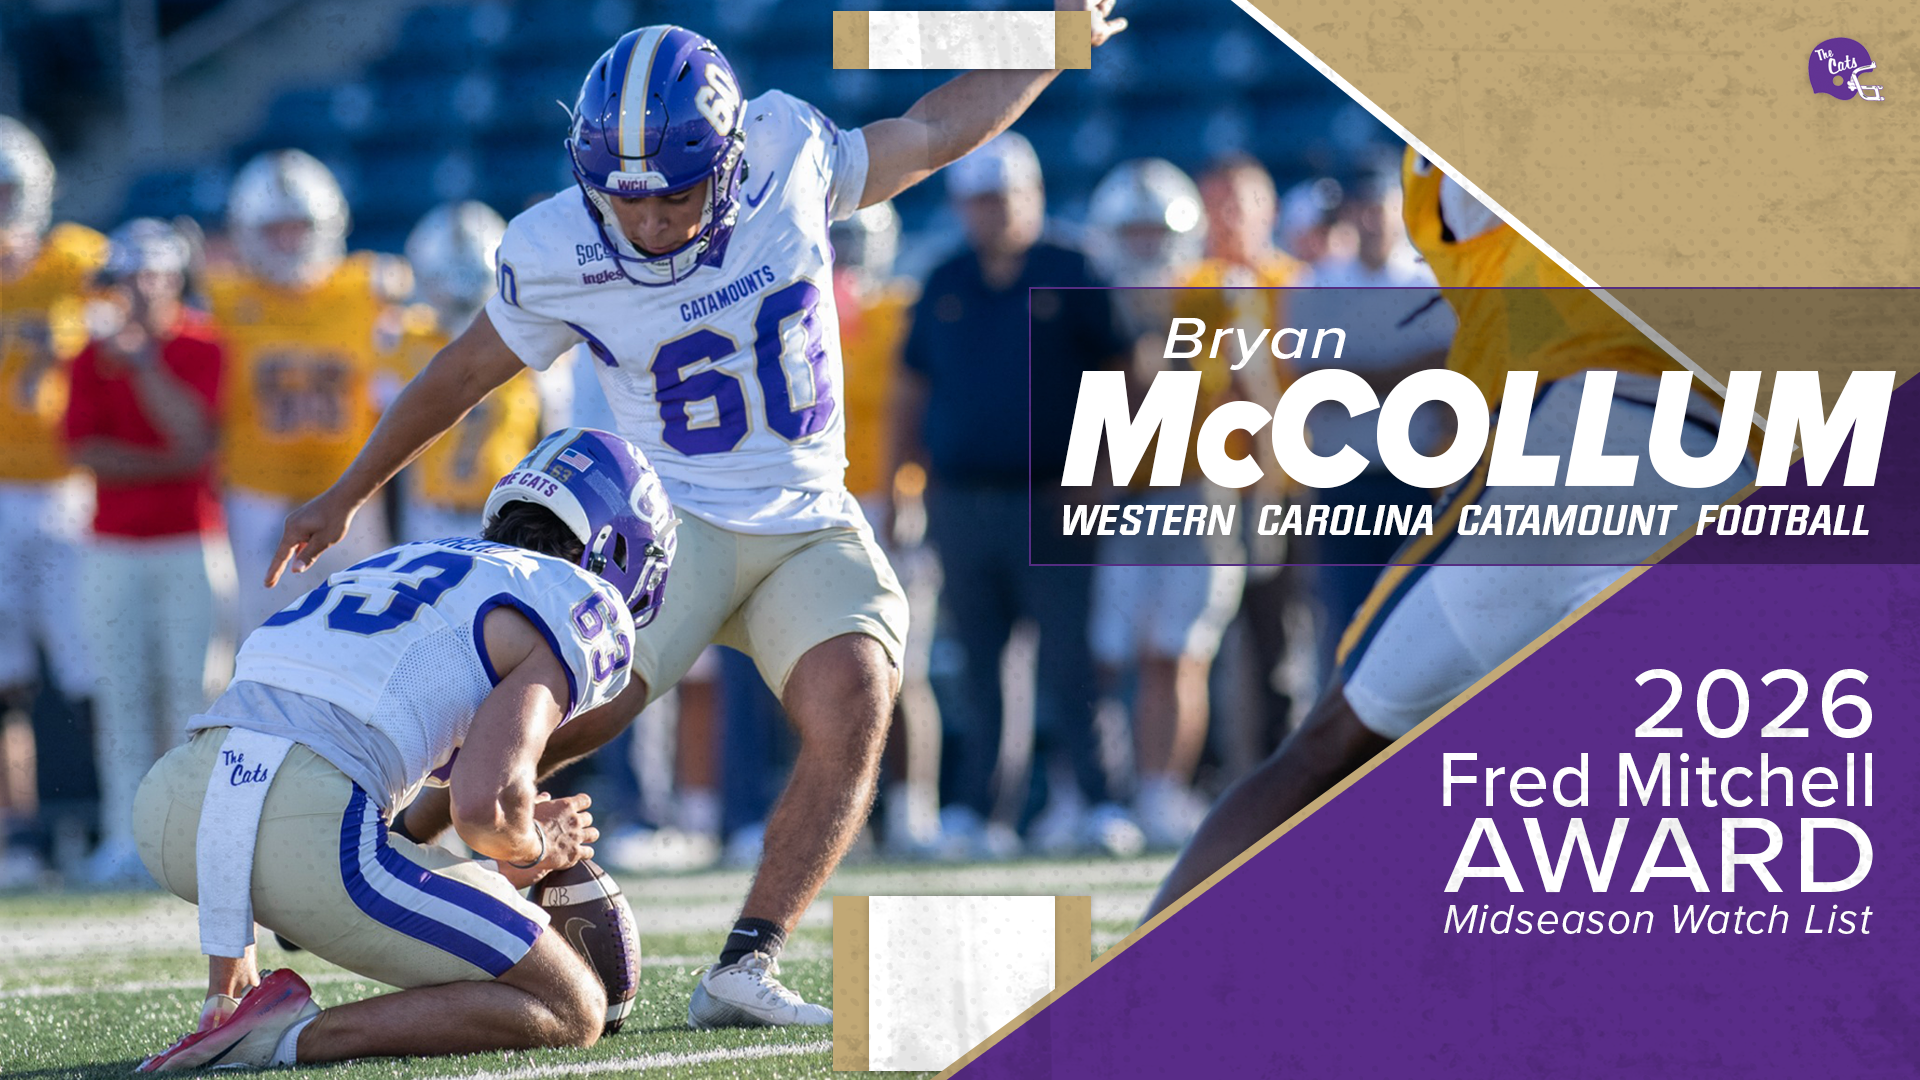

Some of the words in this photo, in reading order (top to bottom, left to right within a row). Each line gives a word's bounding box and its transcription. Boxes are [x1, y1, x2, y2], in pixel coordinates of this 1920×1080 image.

[695, 63, 741, 137] 60
[617, 179, 648, 191] WCU
[582, 269, 624, 285] ingles
[680, 264, 775, 322] CATAMOUNTS
[647, 275, 835, 457] 60
[518, 472, 559, 498] CATS
[549, 464, 573, 483] 63
[569, 588, 631, 687] 63
[222, 750, 245, 766] The
[230, 763, 268, 786] Cats
[548, 886, 570, 907] QB
